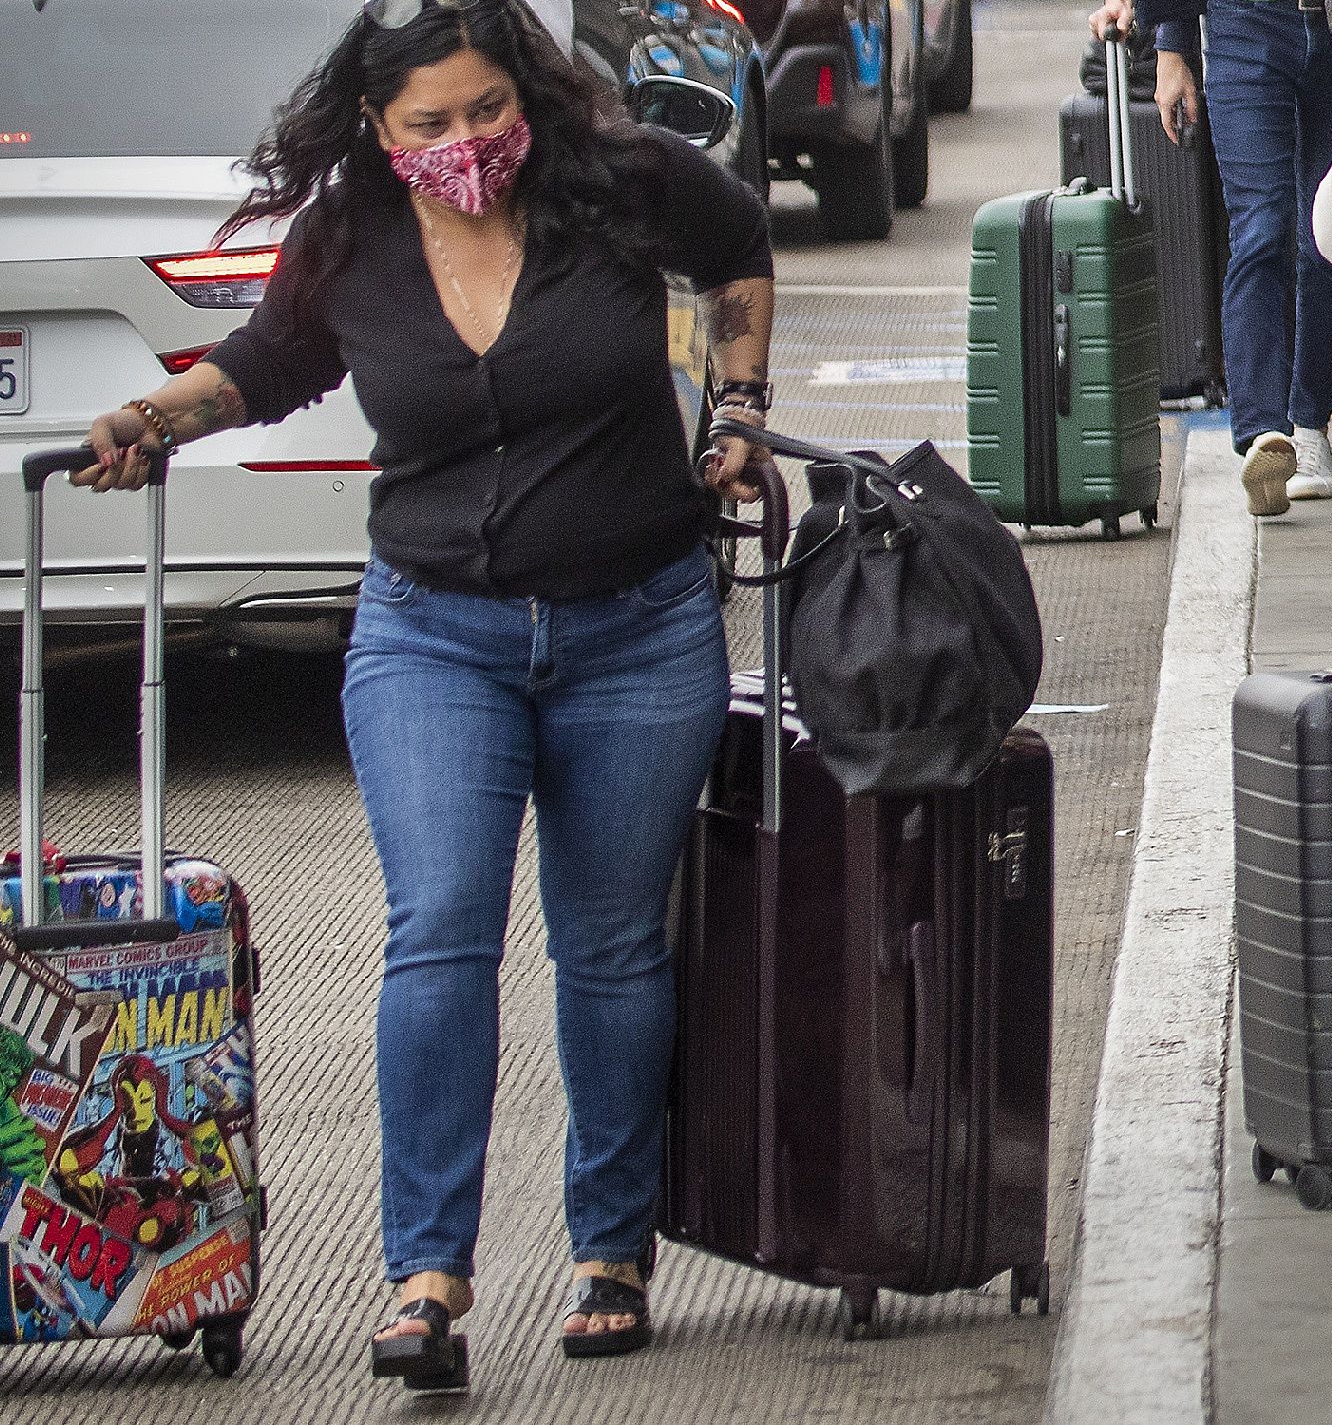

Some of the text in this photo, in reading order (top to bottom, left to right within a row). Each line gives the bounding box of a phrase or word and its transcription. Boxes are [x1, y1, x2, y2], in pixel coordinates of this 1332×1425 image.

[69, 937, 209, 970] MARVEL COMICS GROUP
[119, 958, 200, 982] INVINCIBLE
[146, 986, 230, 1051] MAN
[20, 1186, 133, 1300] THOR
[160, 1268, 213, 1307] POWER
